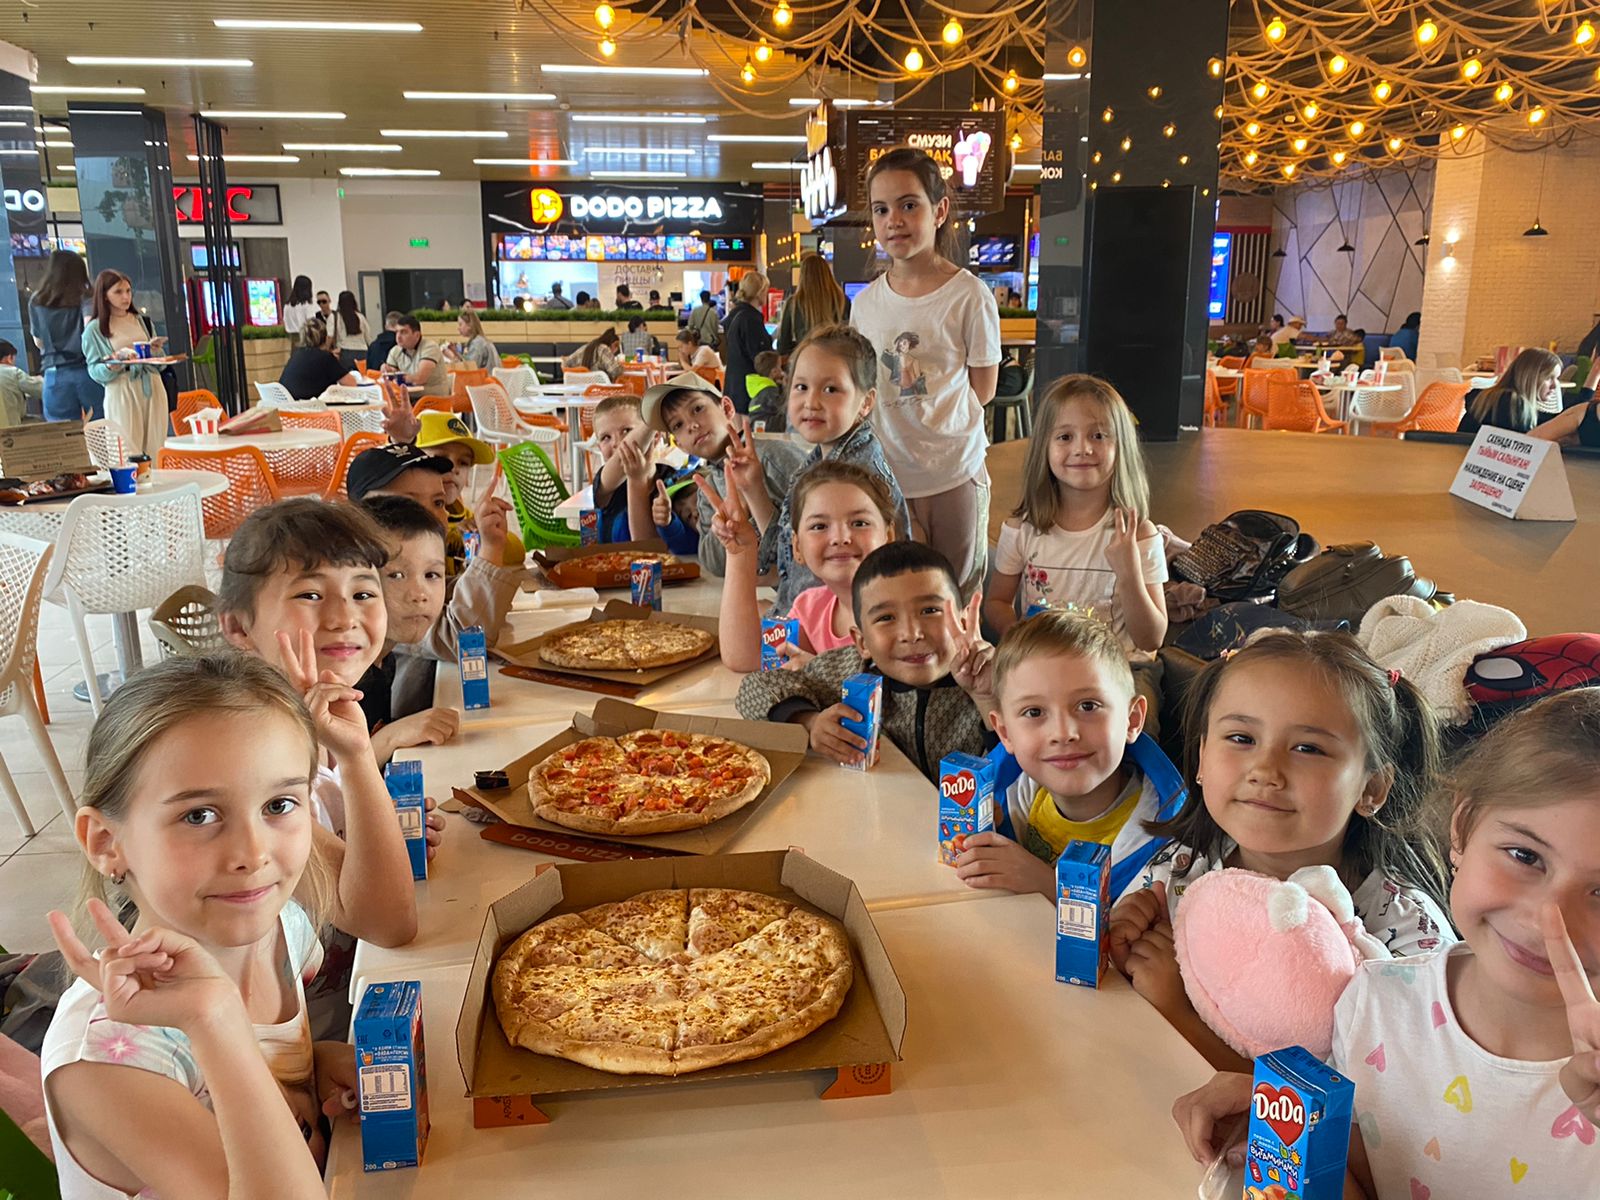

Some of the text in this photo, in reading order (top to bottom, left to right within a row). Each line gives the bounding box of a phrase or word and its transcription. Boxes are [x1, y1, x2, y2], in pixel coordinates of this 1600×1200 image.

[908, 134, 952, 148] СМУЗИ
[570, 196, 723, 218] DODO PIZZA
[762, 627, 786, 645] DaDa
[940, 776, 975, 797] DaDa
[510, 834, 624, 861] DODO PIZZ
[1252, 1092, 1304, 1125] DaDa
